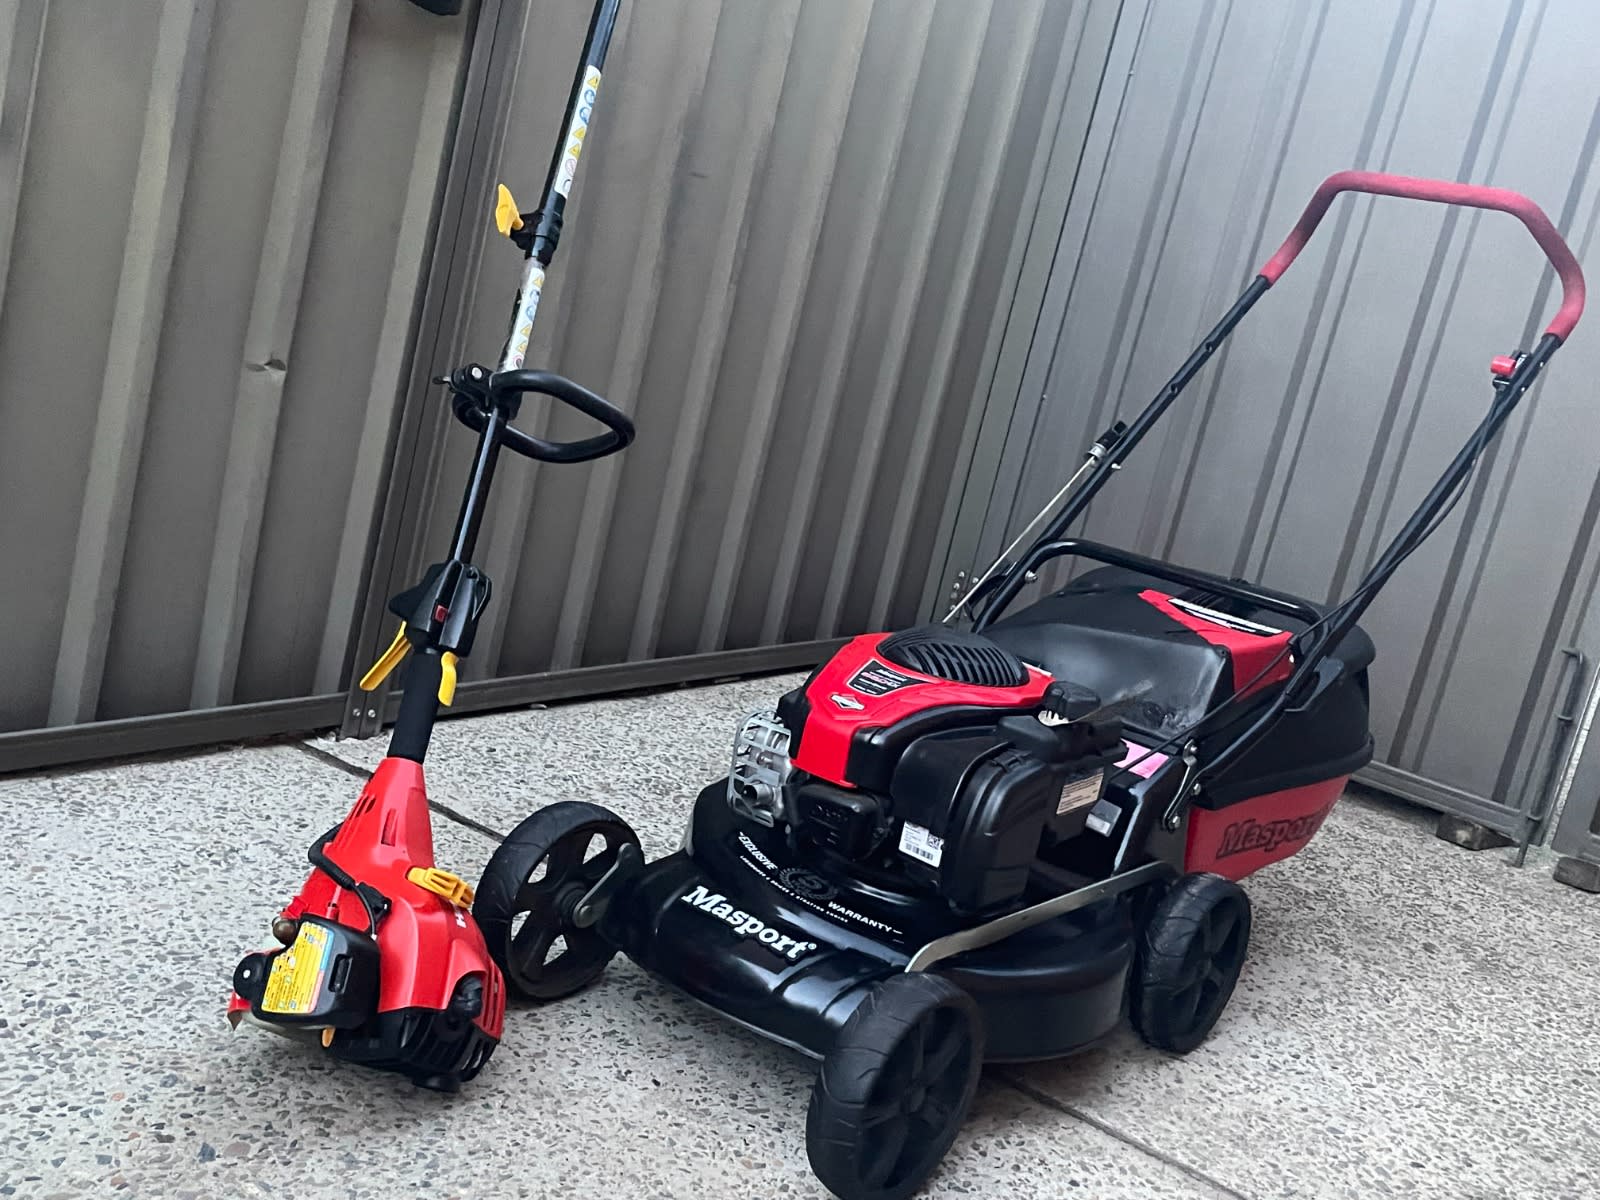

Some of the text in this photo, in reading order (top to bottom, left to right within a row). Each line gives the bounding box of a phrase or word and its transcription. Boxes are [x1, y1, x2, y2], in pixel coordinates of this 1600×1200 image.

[1216, 811, 1325, 859] Maspor
[738, 835, 778, 870] EXCLUSIVE
[828, 901, 892, 933] WARRANTY
